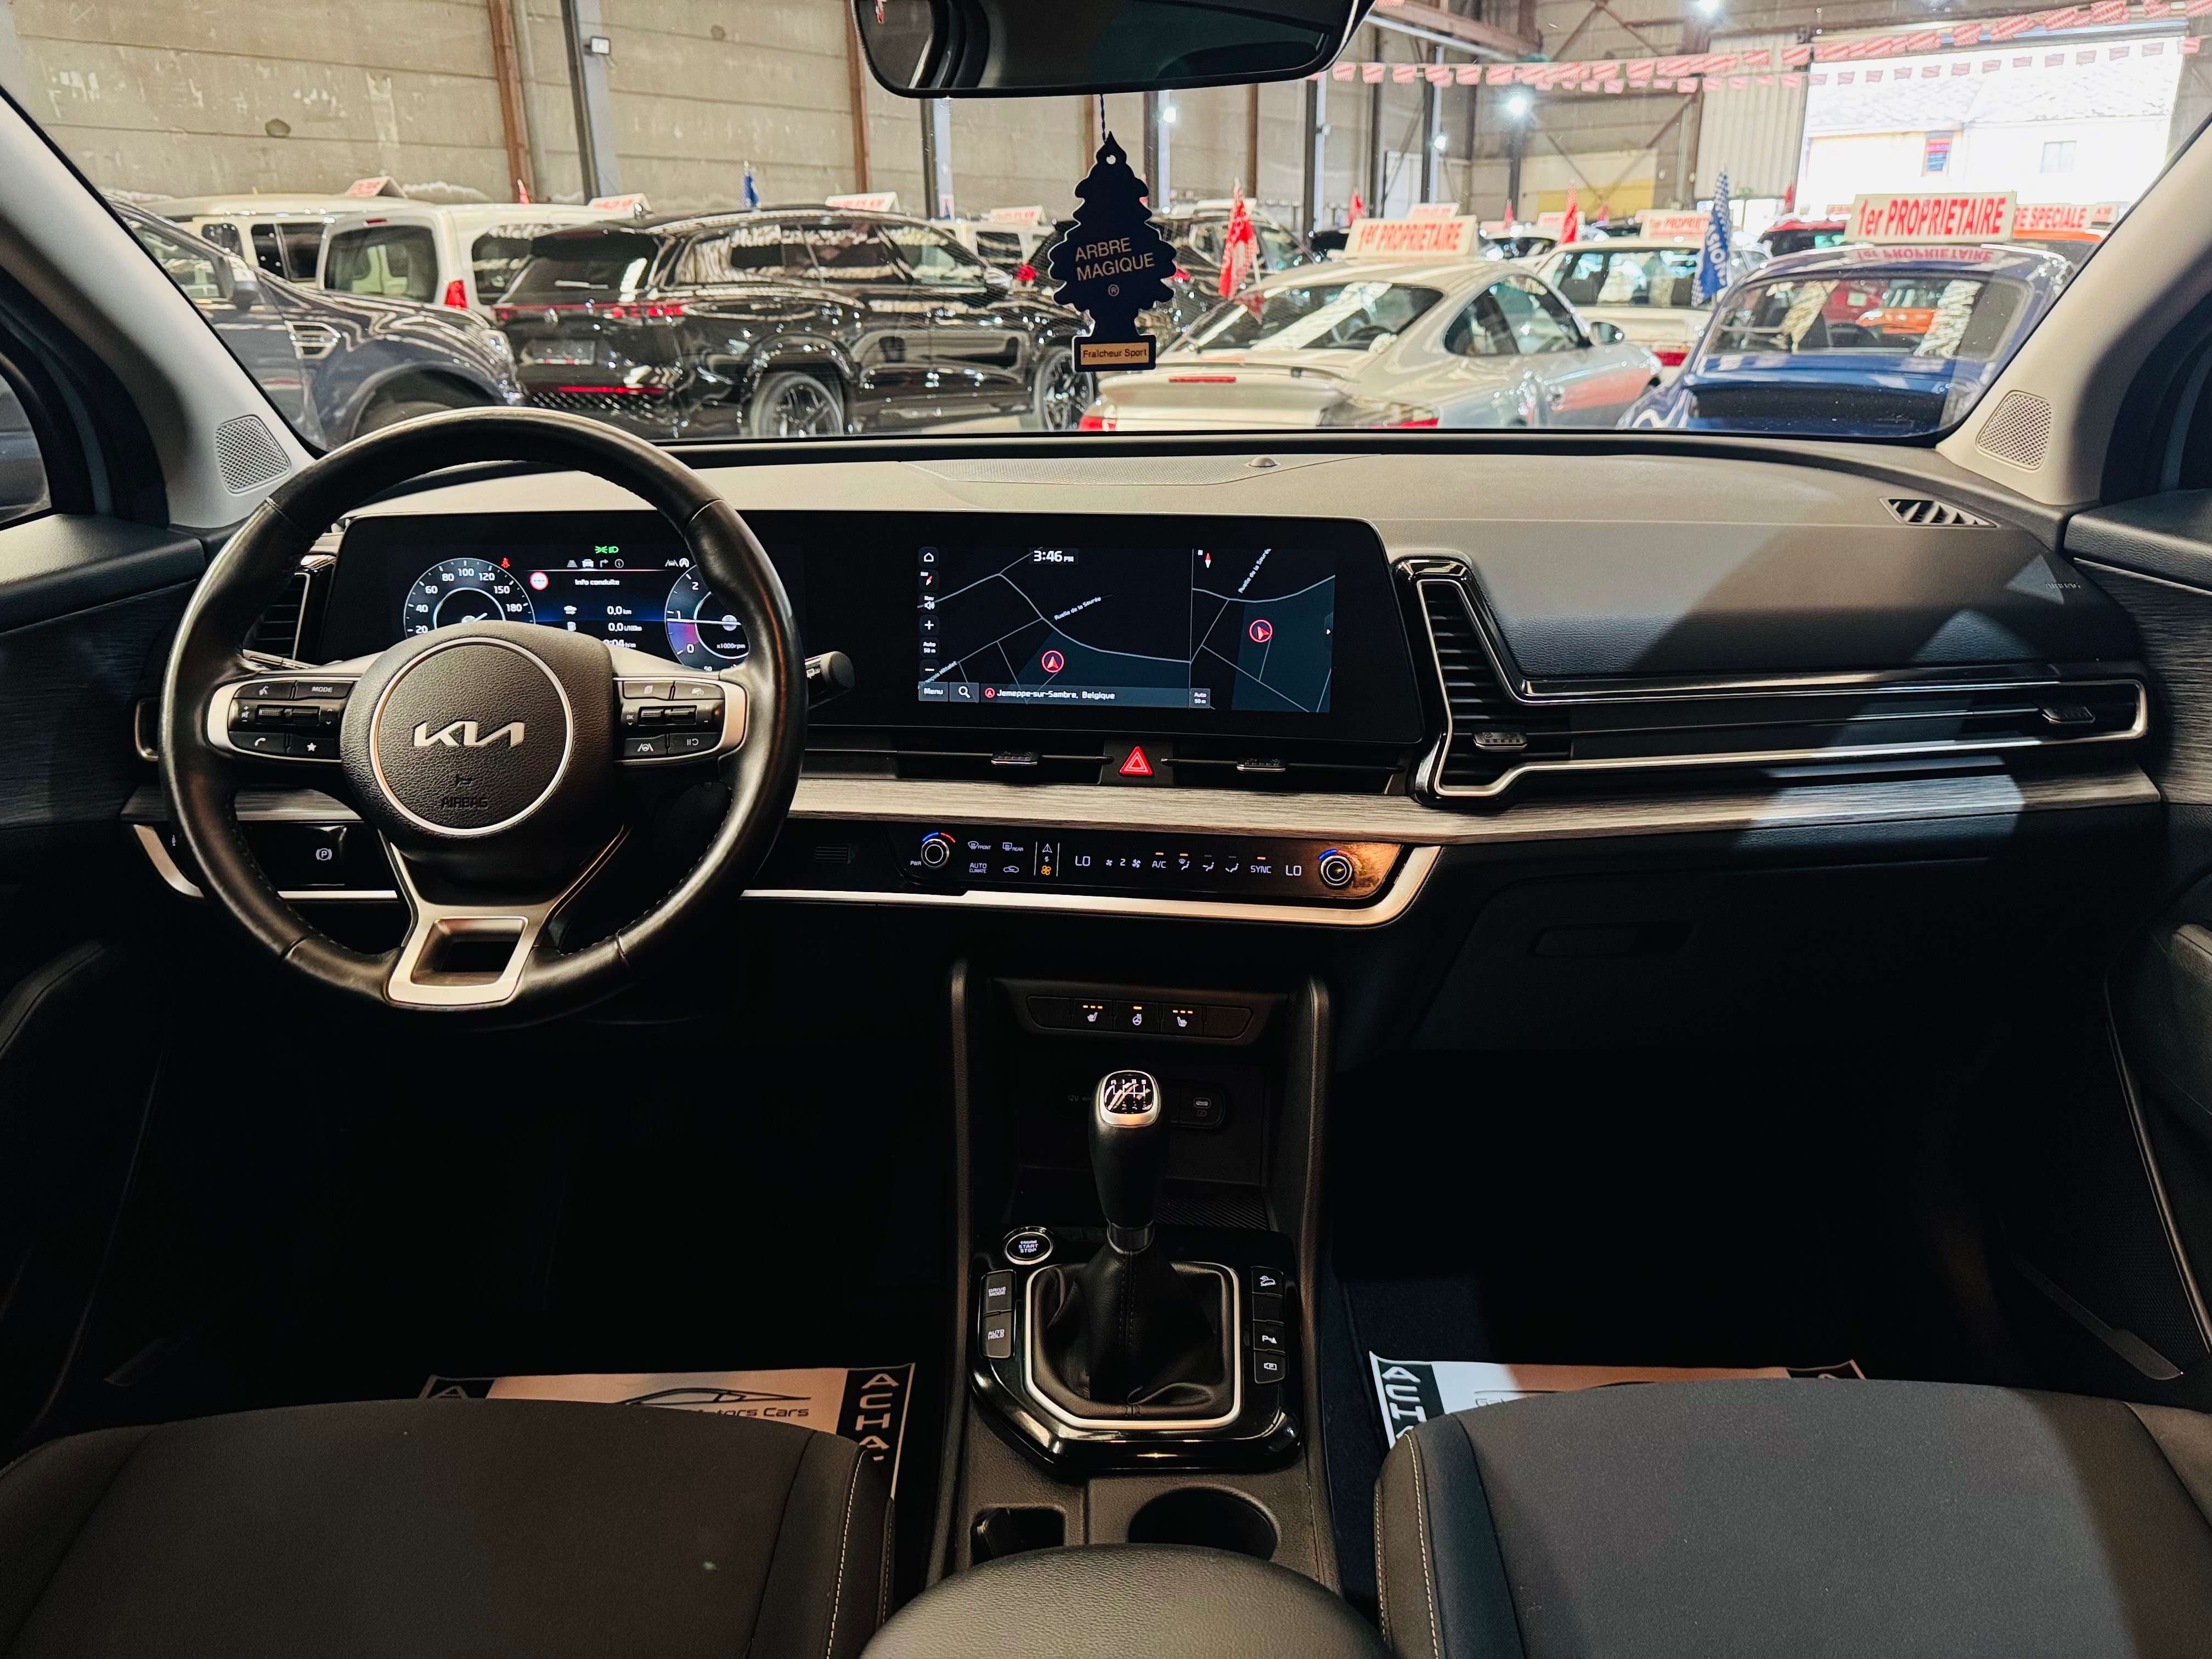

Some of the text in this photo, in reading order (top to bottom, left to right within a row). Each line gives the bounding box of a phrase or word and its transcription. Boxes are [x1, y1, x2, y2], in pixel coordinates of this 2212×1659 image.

[1858, 197, 2006, 236] 1er PROPRIETAIRE
[2030, 206, 2087, 228] SPECIALE
[1376, 223, 1463, 251] PROPRIETAIRE
[1075, 238, 1132, 262] ARBRE
[1076, 252, 1155, 281] MAGIQUE
[1125, 348, 1147, 358] Sport
[1033, 550, 1063, 563] 3:46
[458, 568, 475, 577] 100
[478, 572, 495, 581] 120
[442, 573, 455, 582] 80
[425, 585, 438, 594] 60
[494, 585, 510, 594] 150
[692, 582, 699, 590] 2
[416, 604, 428, 613] 40
[506, 603, 523, 612] 180
[676, 610, 682, 619] 1
[415, 625, 428, 634] 20
[686, 644, 695, 653] 0
[923, 687, 944, 696] Menu
[996, 689, 1115, 700] Jemeppe-sur-Sambre, Belgique
[413, 719, 525, 749] KIA
[1075, 856, 1091, 867] LO
[1120, 858, 1126, 866] 2
[1152, 861, 1167, 869] A/C
[1250, 865, 1272, 874] SYNC
[1285, 865, 1302, 876] LO
[763, 1407, 809, 1418] Cars
